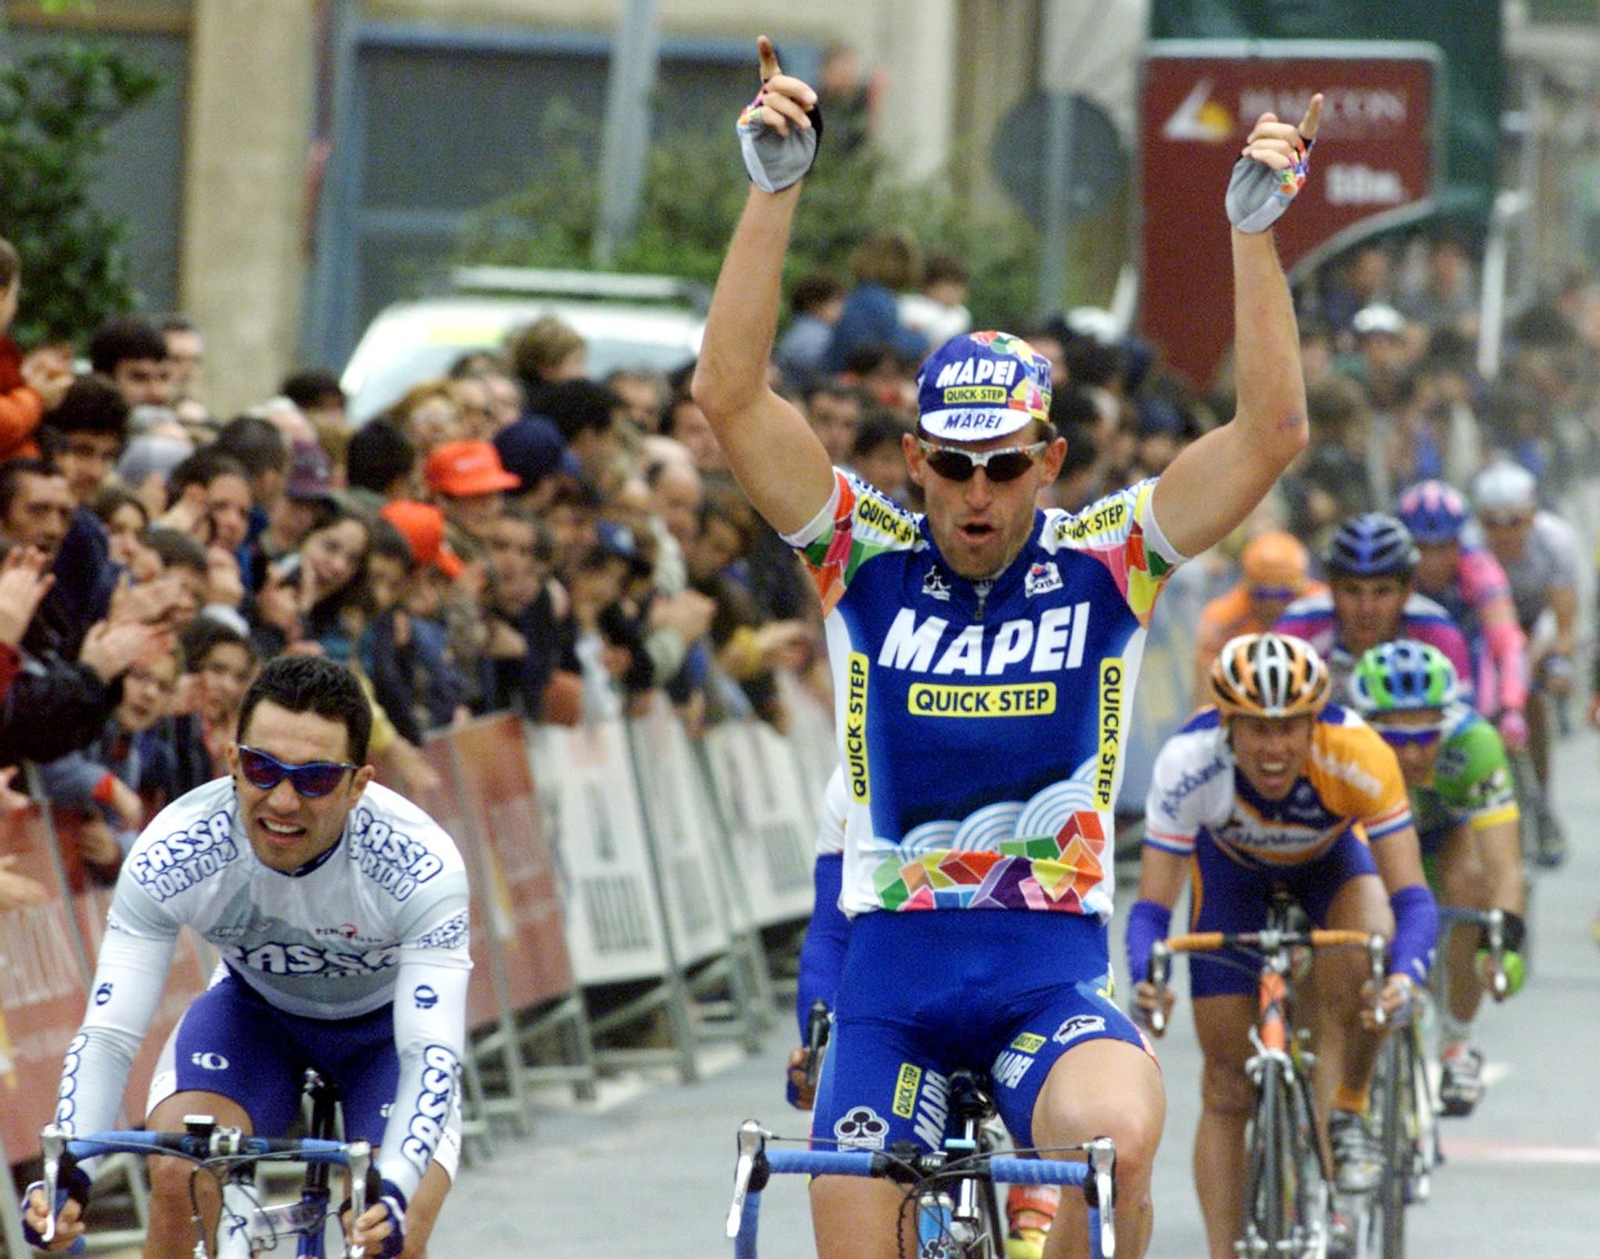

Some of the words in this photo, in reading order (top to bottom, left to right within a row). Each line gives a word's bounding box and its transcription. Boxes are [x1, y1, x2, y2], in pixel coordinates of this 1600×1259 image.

[935, 357, 1017, 388] MAPEI
[943, 414, 1003, 430] MAPEI
[877, 602, 1090, 675] MAPEI
[128, 810, 234, 885] FASSA
